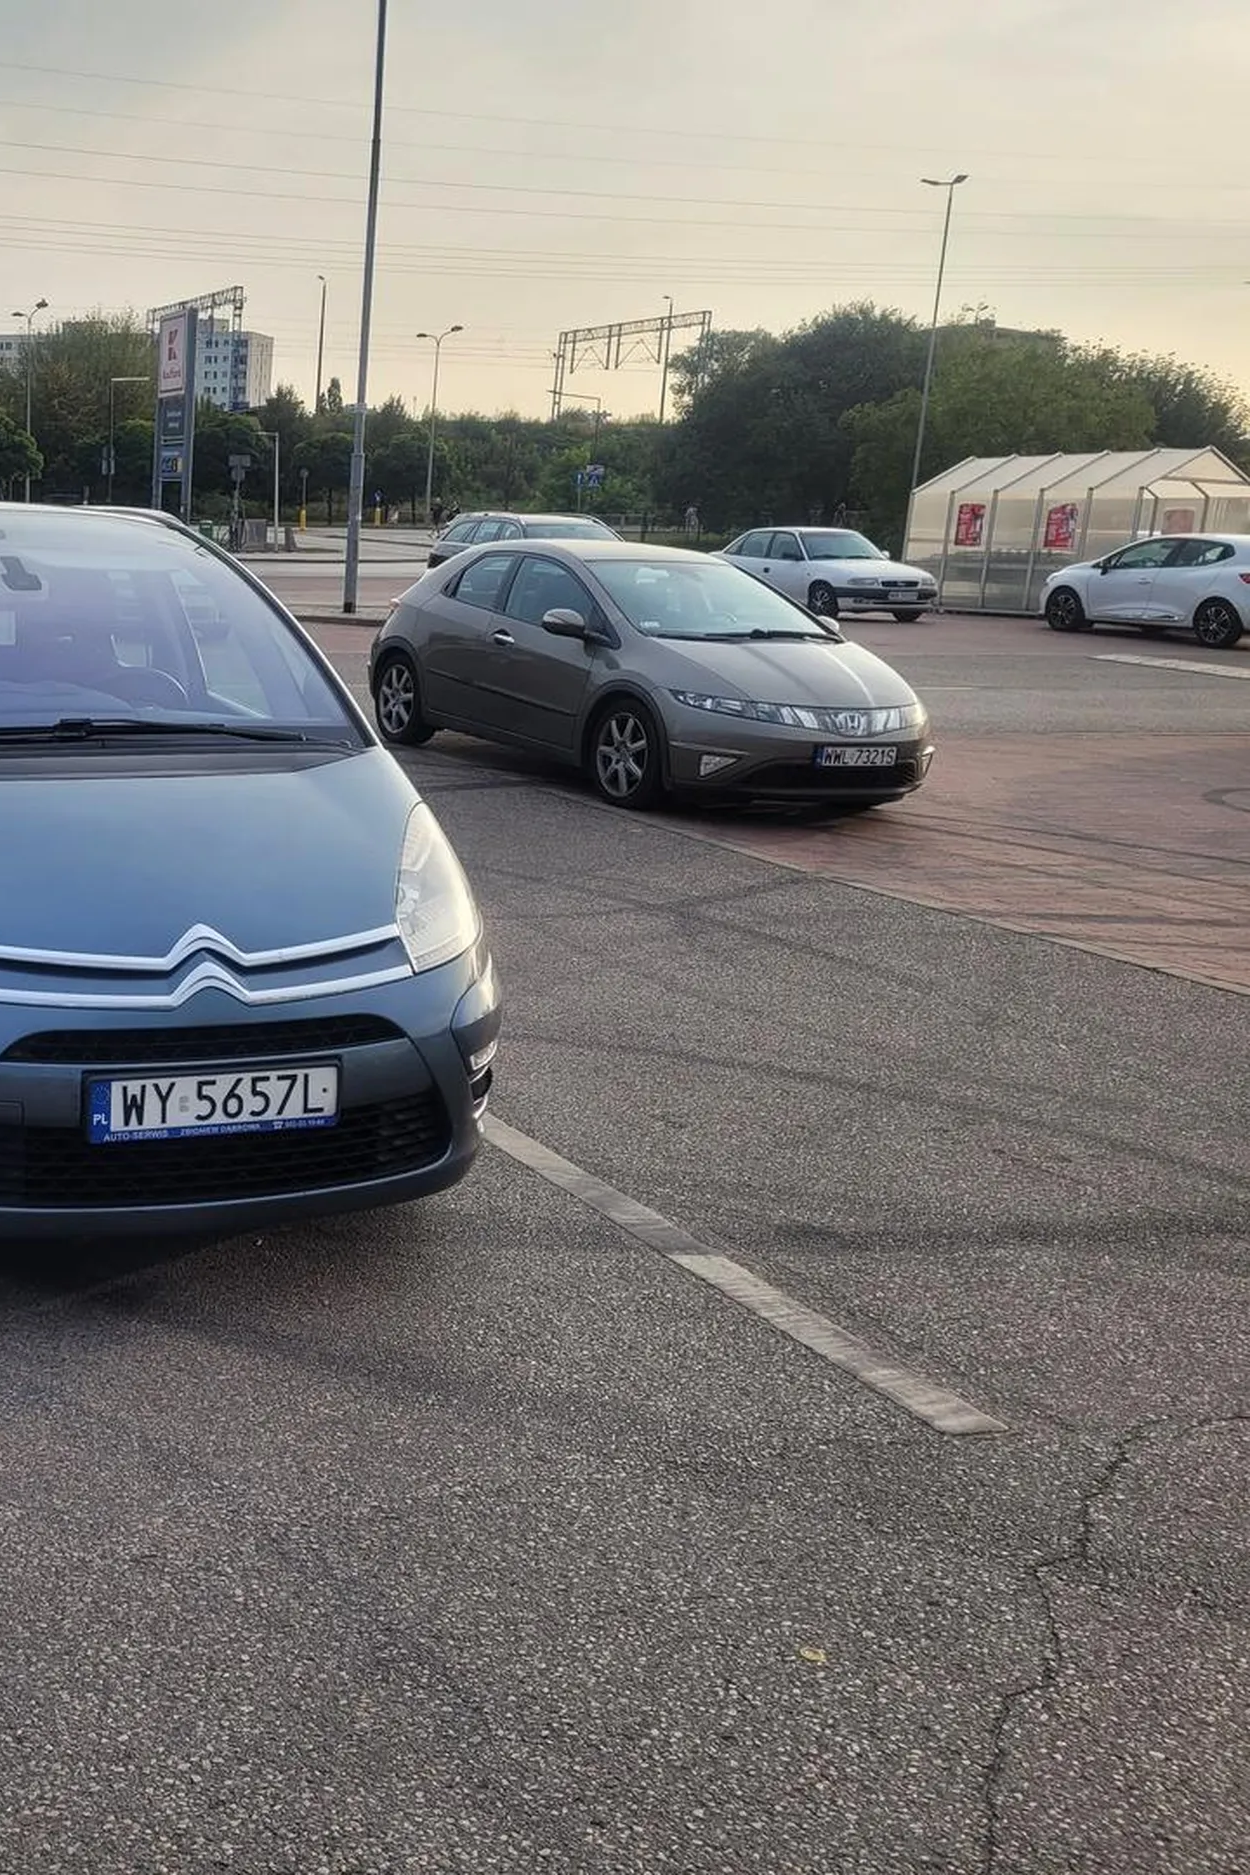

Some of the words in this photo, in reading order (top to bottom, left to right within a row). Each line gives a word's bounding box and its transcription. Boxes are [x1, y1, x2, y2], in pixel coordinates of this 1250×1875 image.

[824, 749, 849, 764] WWL
[121, 1081, 176, 1127] WY
[194, 1073, 325, 1121] 5657L
[92, 1113, 108, 1126] PL
